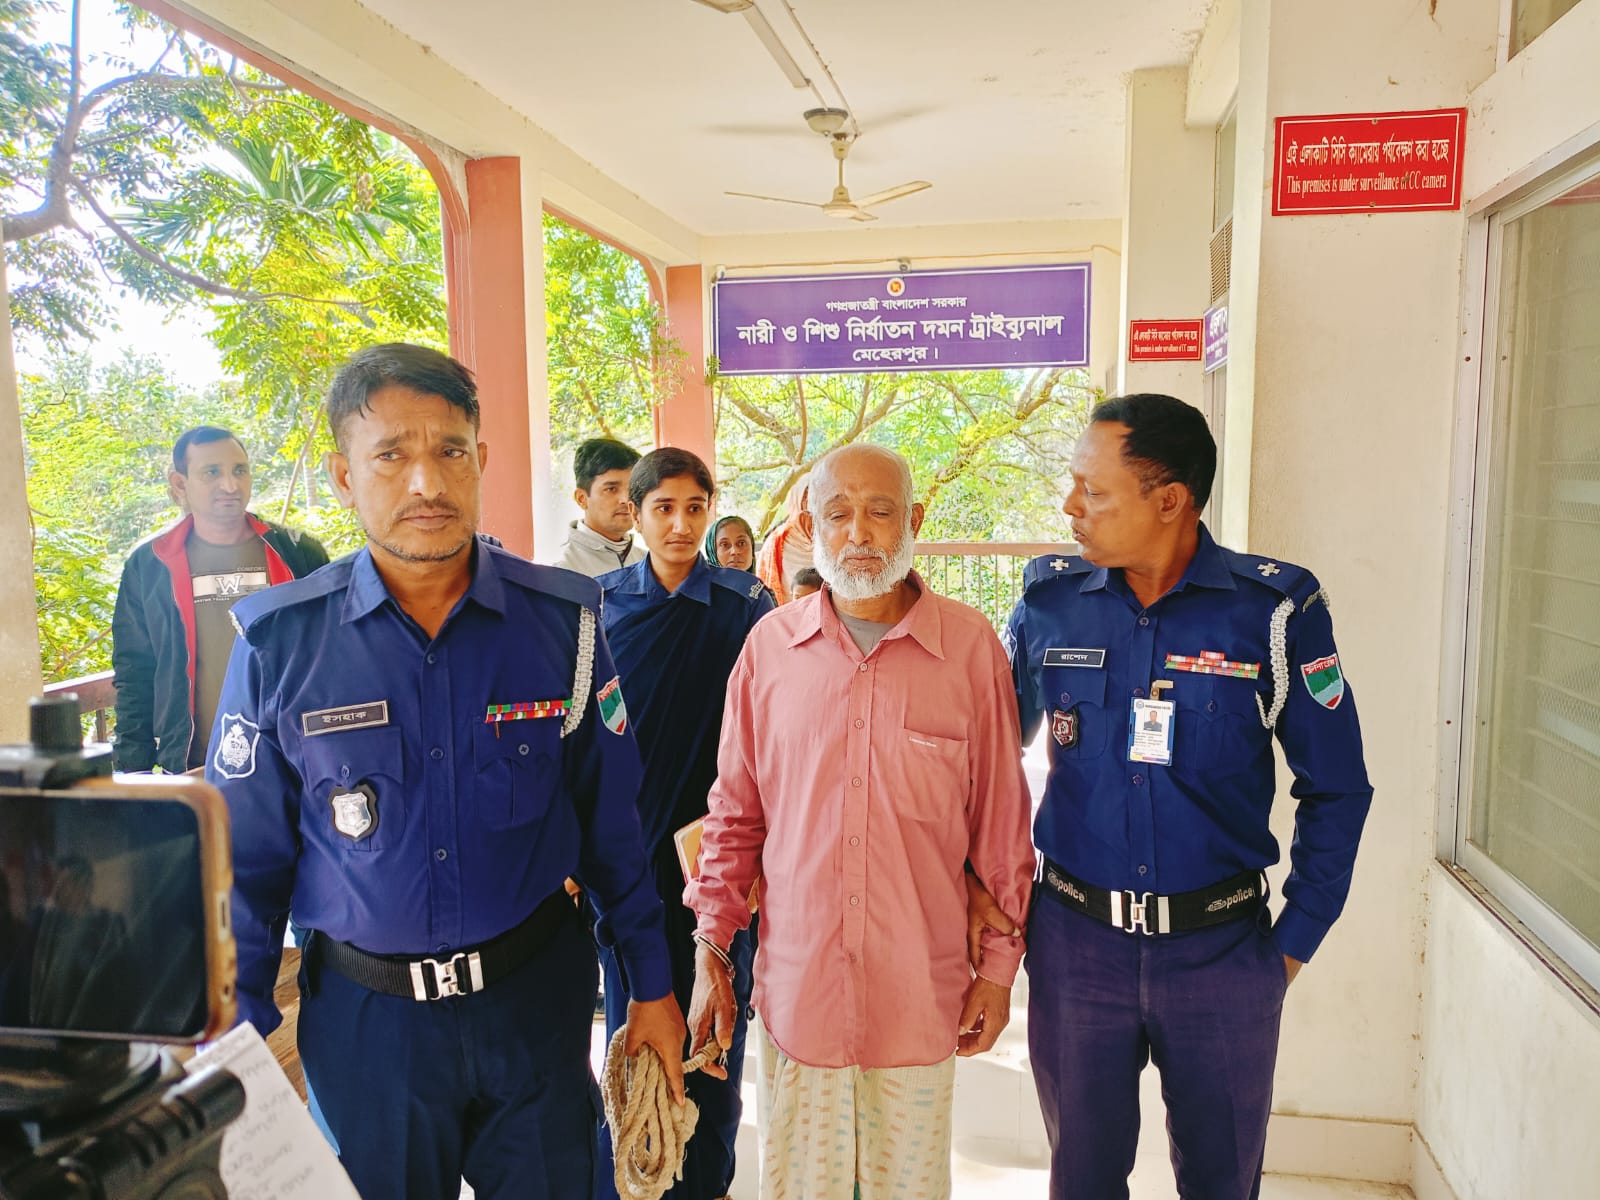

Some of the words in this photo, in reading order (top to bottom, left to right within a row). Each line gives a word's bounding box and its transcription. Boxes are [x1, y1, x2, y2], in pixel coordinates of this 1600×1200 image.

[1286, 137, 1298, 168] এই
[1300, 136, 1329, 167] এলাকাটি
[1331, 135, 1346, 166] সিসি
[1348, 142, 1380, 166] ক্যামেরায়
[1382, 132, 1413, 164] পর্যবেক্ষণ
[1415, 139, 1430, 162] করা
[1431, 138, 1450, 164] হচ্ছে
[1287, 175, 1300, 193] This
[1301, 174, 1330, 198] premises
[1331, 174, 1337, 192] is
[1338, 173, 1359, 192] under
[1359, 171, 1399, 191] surveillance
[1400, 171, 1409, 190] of
[1408, 170, 1421, 190] CC
[1421, 175, 1447, 189] camera
[881, 298, 929, 311] বাংলাদেশ
[931, 296, 967, 308] সরকার
[736, 318, 777, 345] নারী
[781, 325, 798, 342] ও
[802, 317, 841, 343] শিশু
[845, 315, 917, 343] নির্যাতন
[920, 318, 966, 340] দমন
[968, 311, 1065, 342] ট্রাইব্যুনাল
[852, 346, 929, 363] মেহেরপুর
[215, 575, 242, 595] W
[1057, 881, 1085, 903] police
[1226, 887, 1253, 909] police
